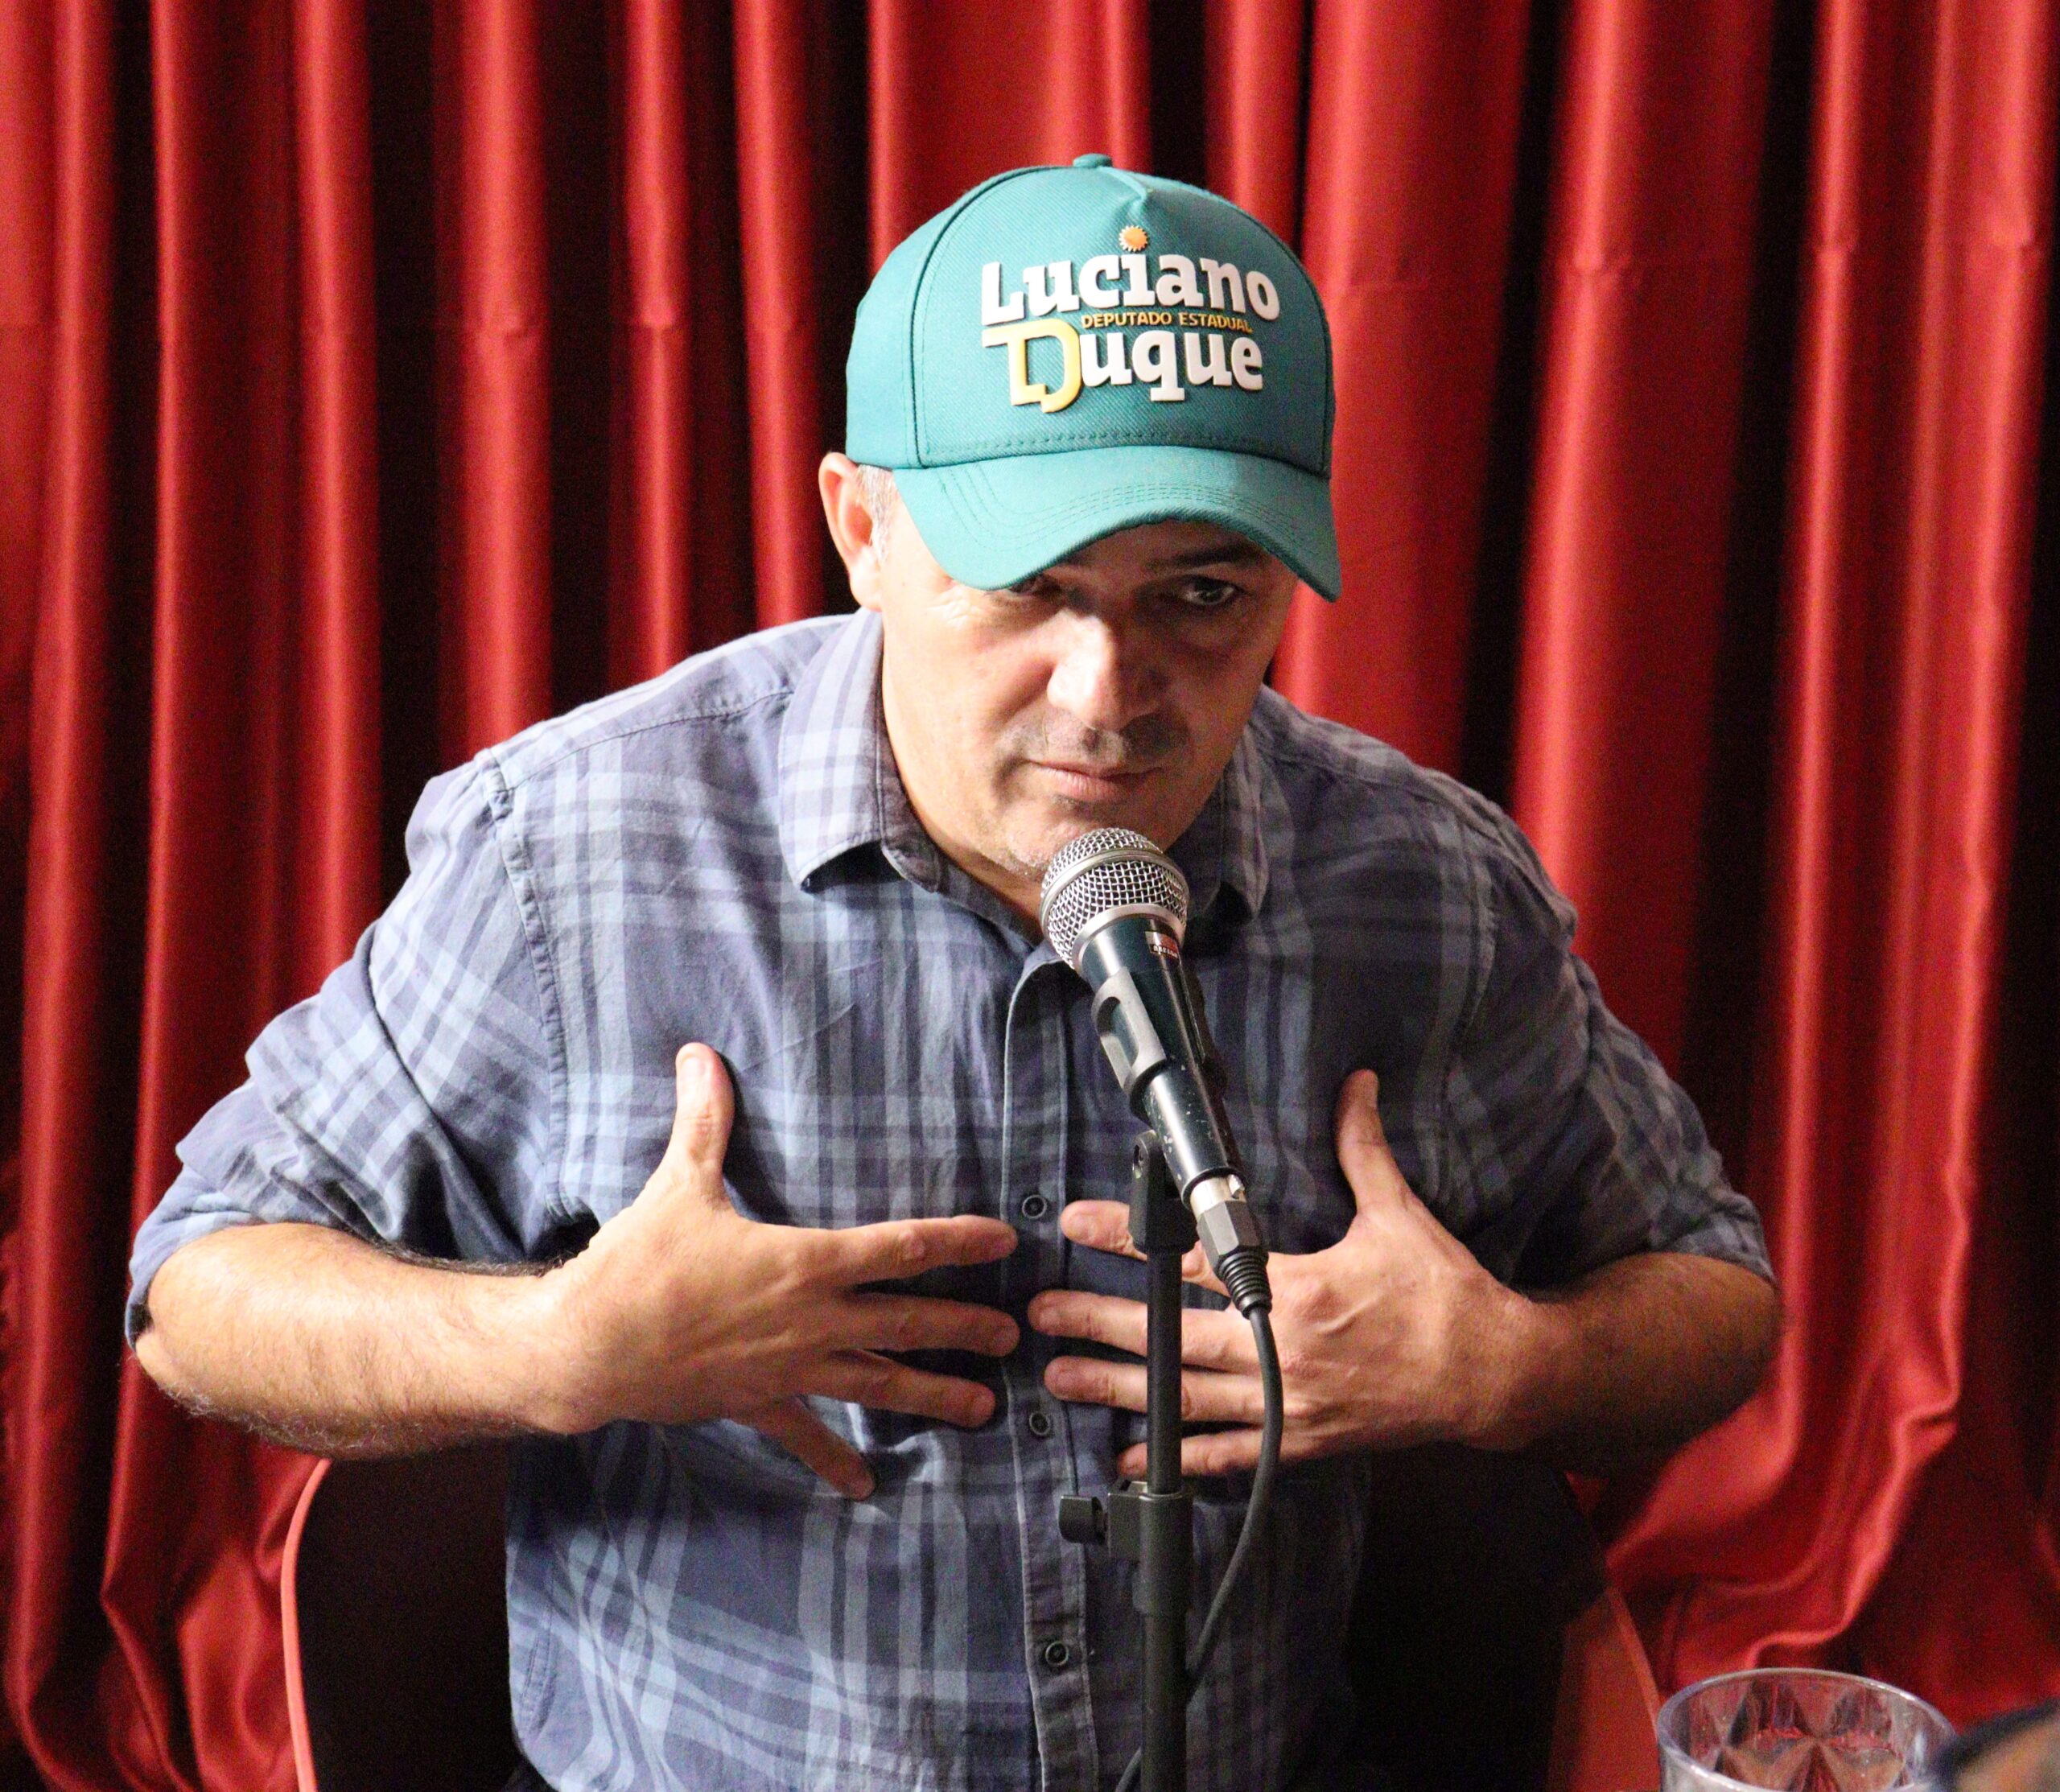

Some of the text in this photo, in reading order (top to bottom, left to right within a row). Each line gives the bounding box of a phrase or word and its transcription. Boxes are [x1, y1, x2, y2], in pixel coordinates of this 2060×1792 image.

[981, 226, 1280, 323] Luciano
[1081, 311, 1254, 332] DEPUTADO ESTADUAL
[982, 319, 1263, 413] Duque
